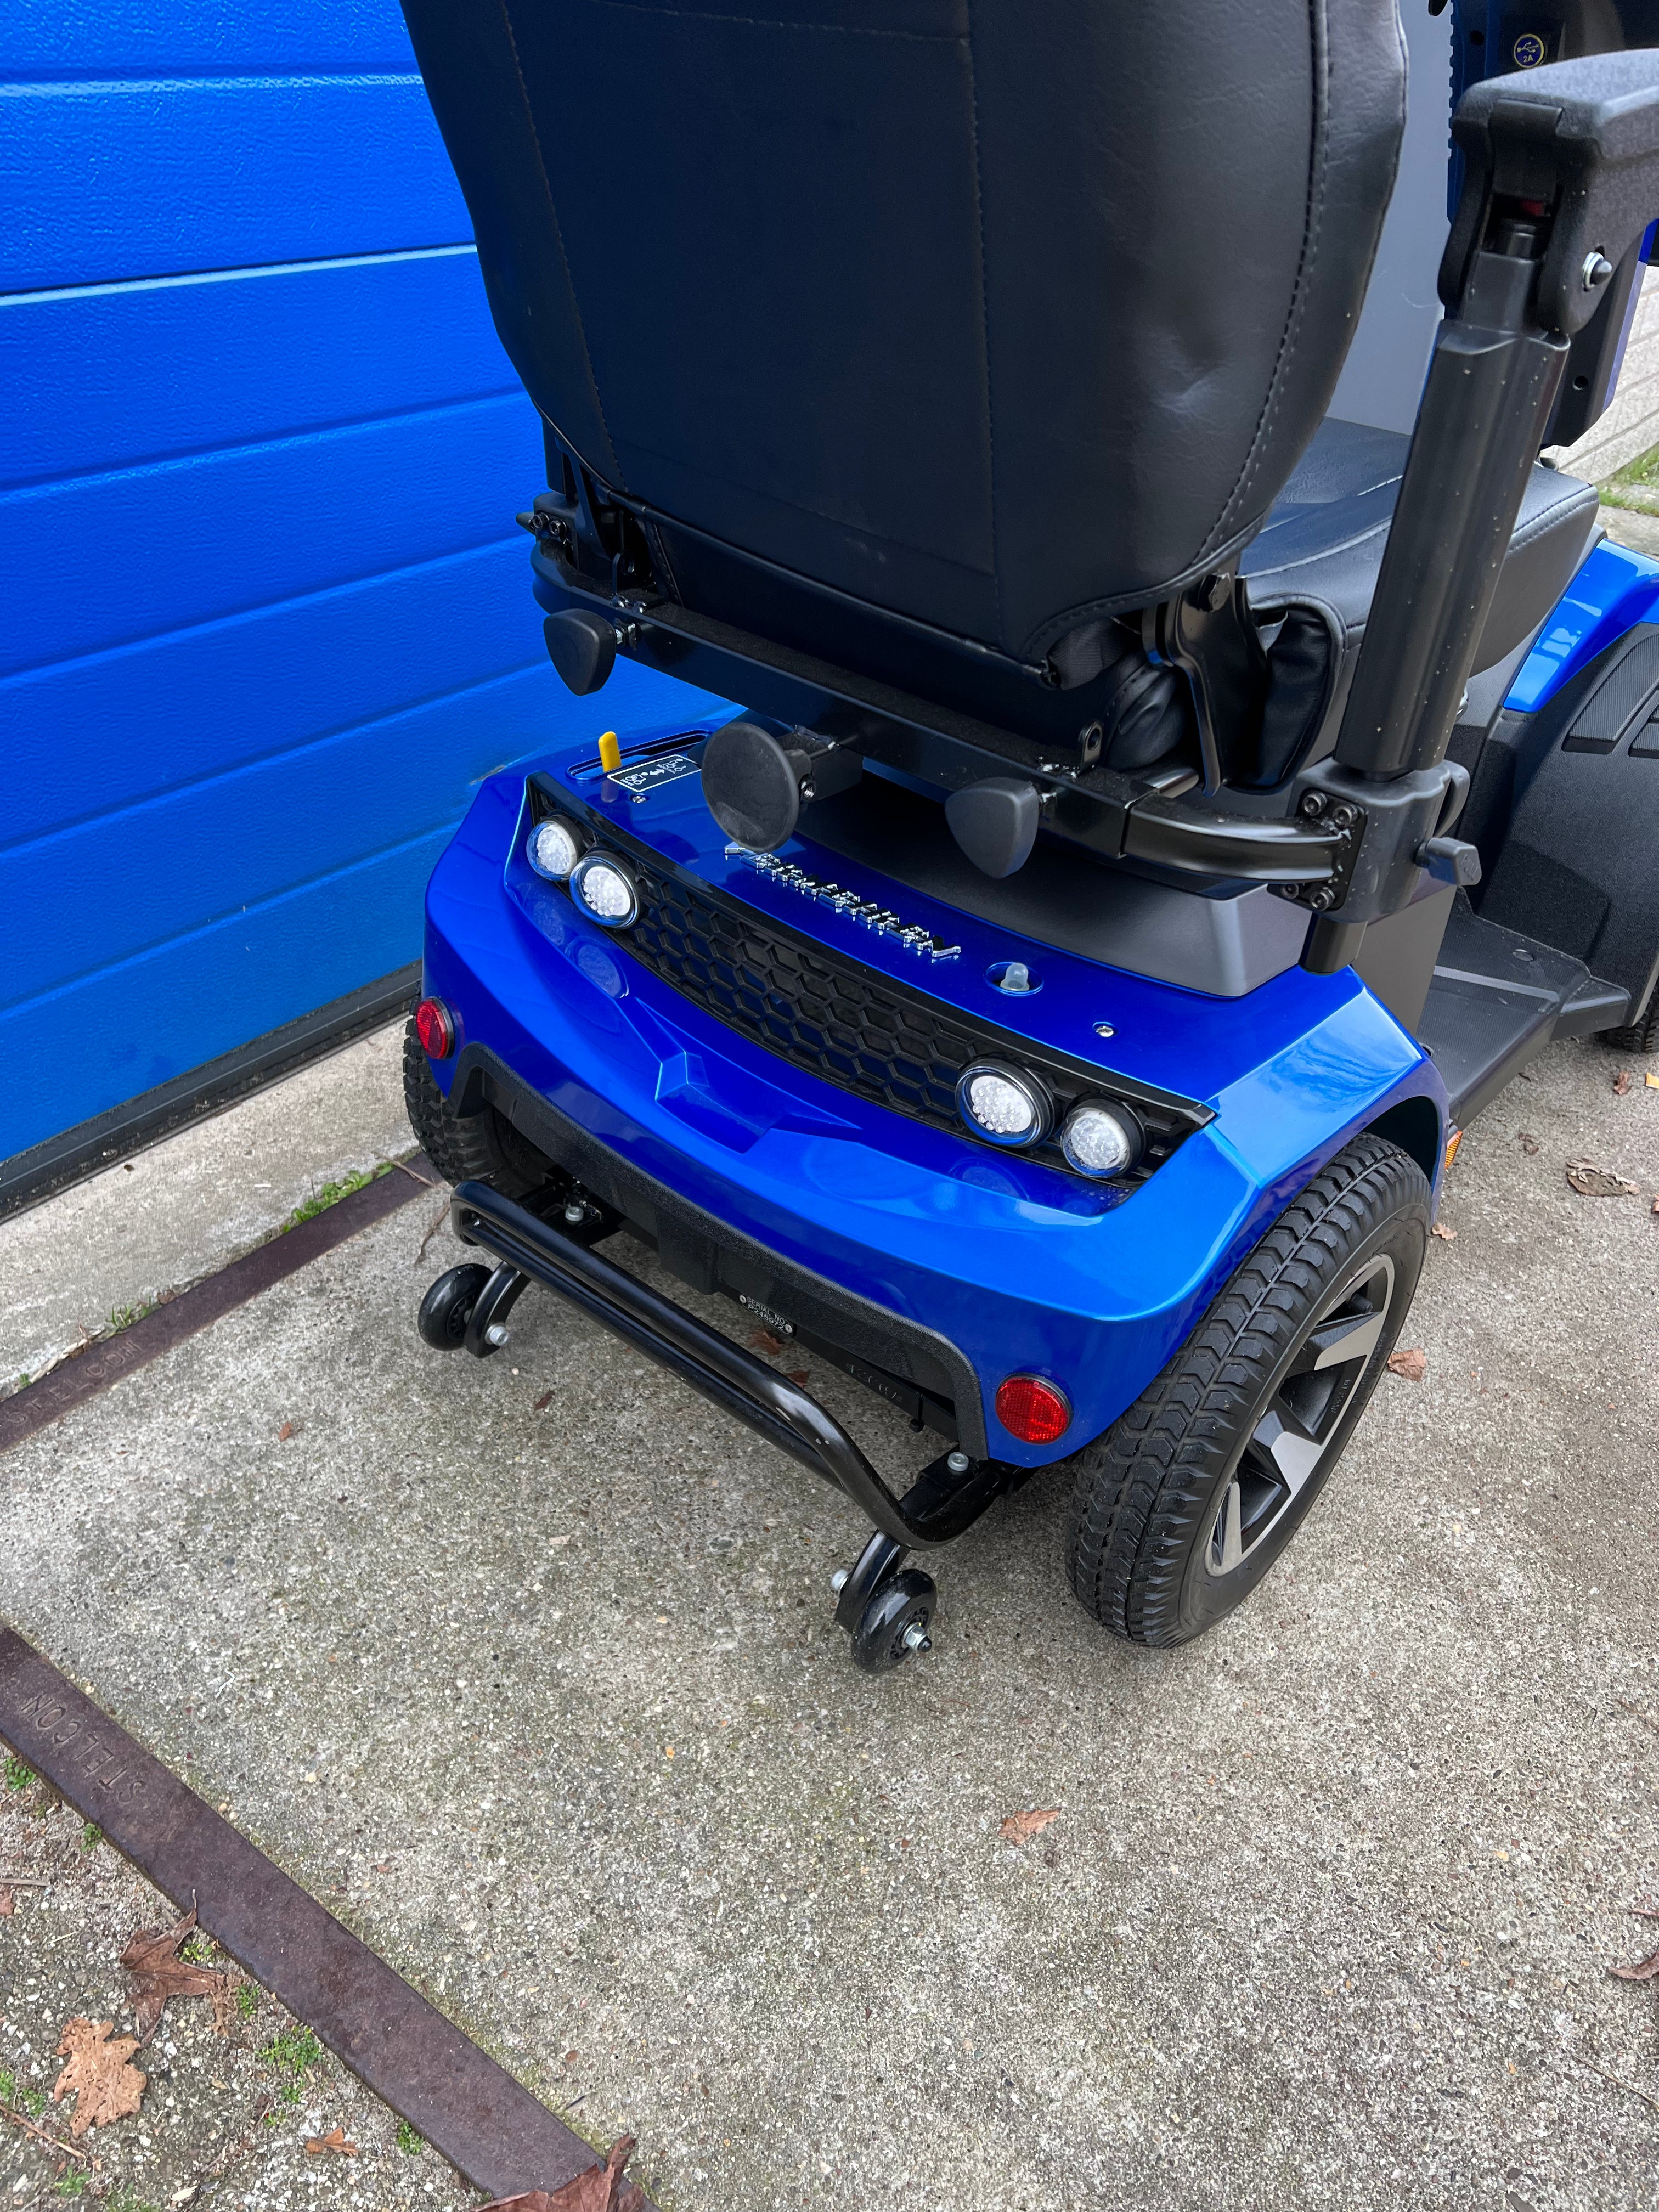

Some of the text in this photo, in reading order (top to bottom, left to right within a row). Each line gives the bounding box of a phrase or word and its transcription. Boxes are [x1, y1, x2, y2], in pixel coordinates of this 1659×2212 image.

[747, 1296, 786, 1324] SERIAL NO
[8, 1340, 143, 1426] STELCON
[21, 1693, 146, 1803] STELCON
